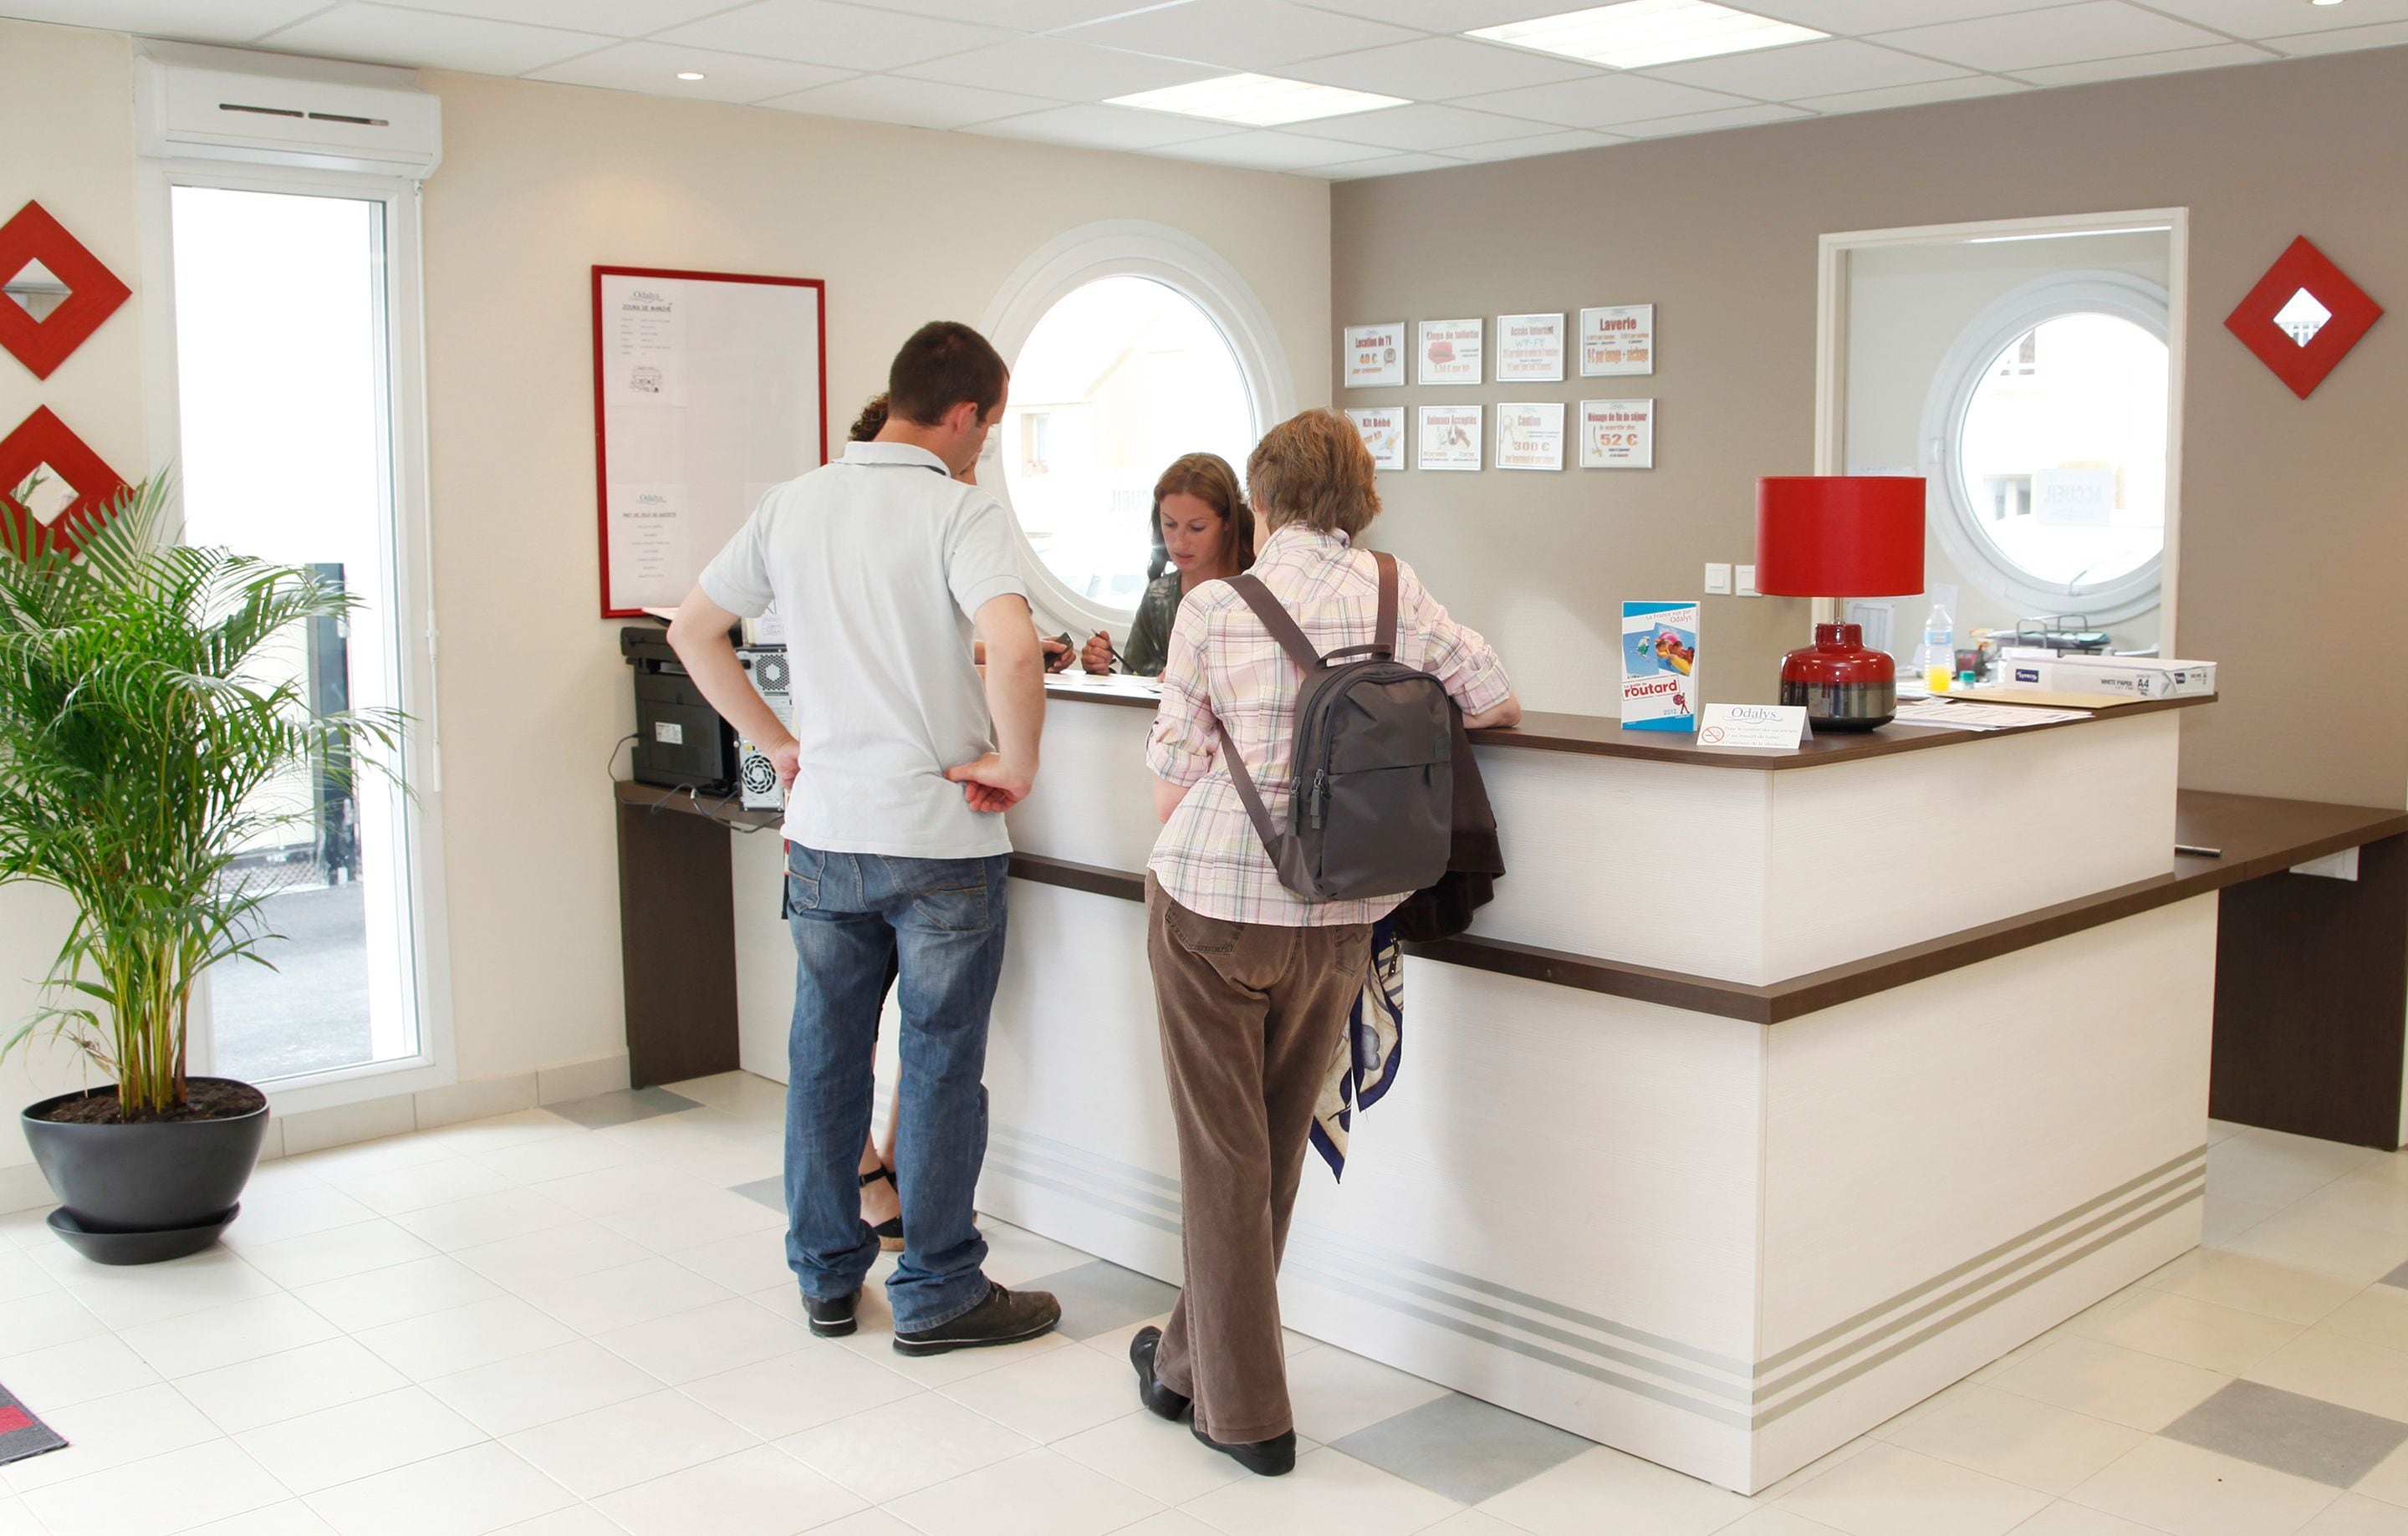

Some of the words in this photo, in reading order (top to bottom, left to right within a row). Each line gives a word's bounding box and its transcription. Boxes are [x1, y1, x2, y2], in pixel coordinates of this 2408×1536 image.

[1599, 317, 1637, 331] Laverie
[1355, 337, 1377, 349] Location
[1378, 335, 1385, 347] de
[1385, 334, 1392, 346] TV
[1600, 434, 1622, 446] 52
[1625, 434, 1638, 446] €
[1670, 615, 1692, 625] Odalys
[1625, 680, 1677, 697] routard
[2137, 678, 2150, 688] A4
[1731, 707, 1778, 720] Odalys
